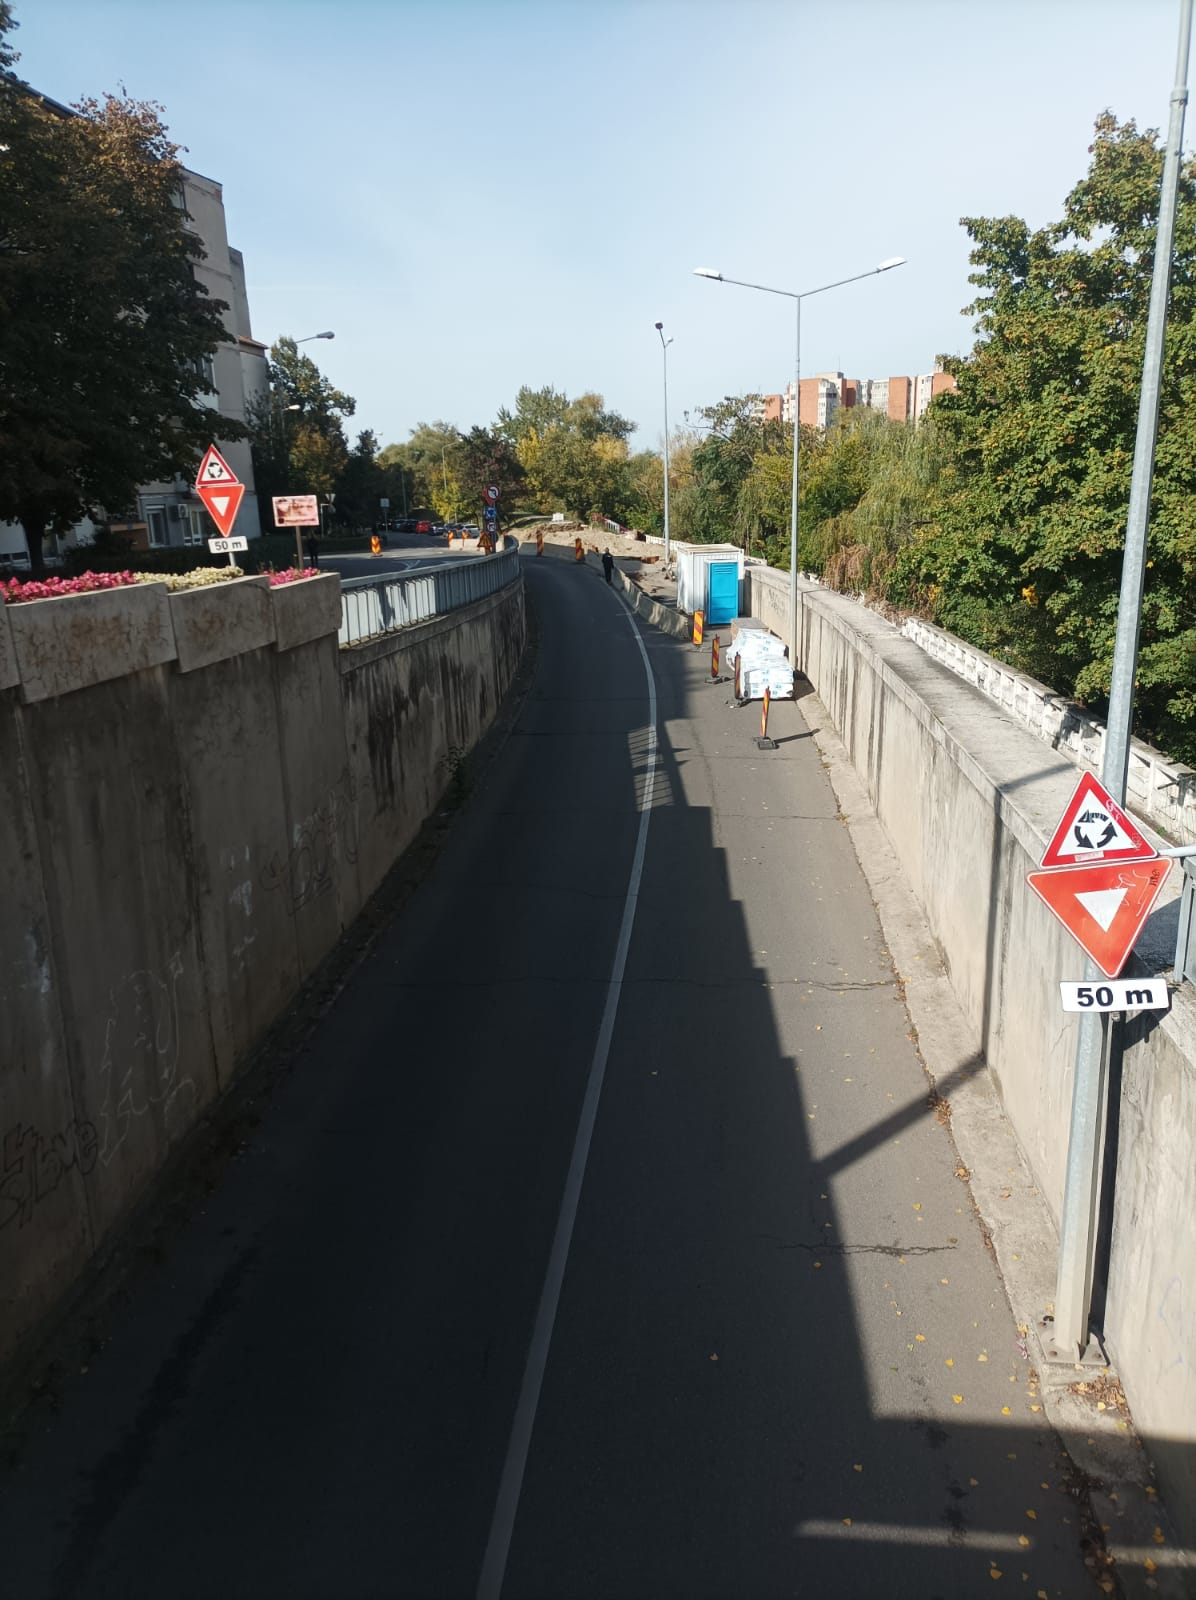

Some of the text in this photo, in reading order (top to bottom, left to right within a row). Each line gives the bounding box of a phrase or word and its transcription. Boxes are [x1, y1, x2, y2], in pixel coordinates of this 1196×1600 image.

[214, 540, 242, 551] 50 m
[1077, 986, 1154, 1007] 50 m
